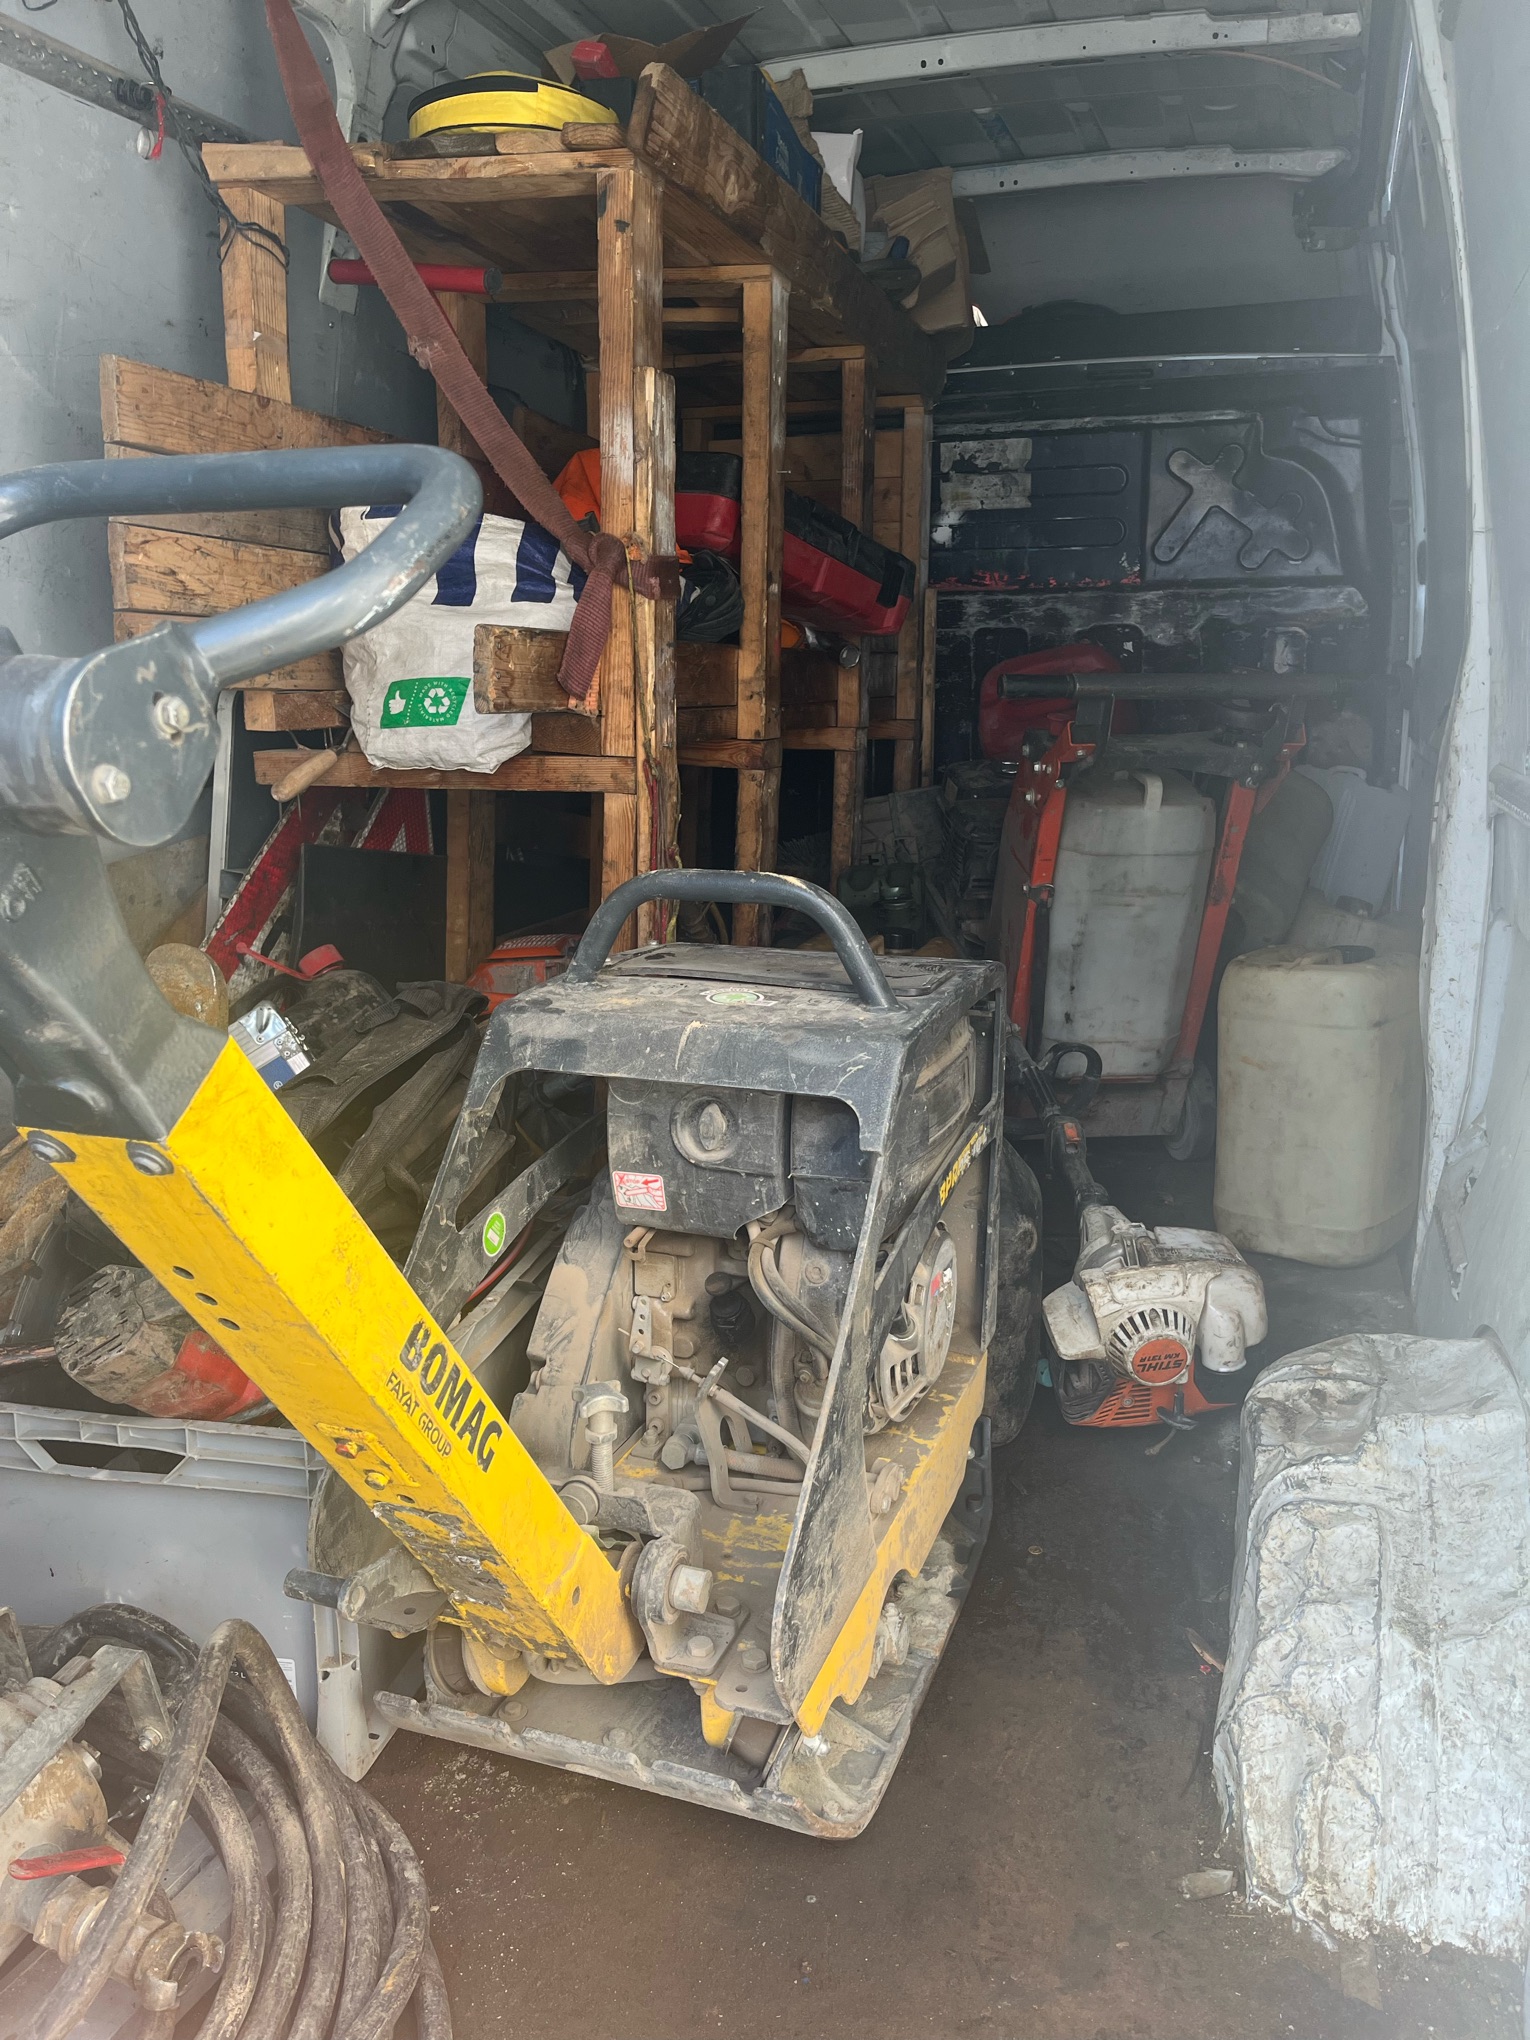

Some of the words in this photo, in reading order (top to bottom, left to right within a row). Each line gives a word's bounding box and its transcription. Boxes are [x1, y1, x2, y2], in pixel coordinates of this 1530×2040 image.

[419, 683, 432, 698] MADE
[433, 681, 449, 689] WITH
[447, 688, 457, 718] RECYCLED
[418, 703, 445, 722] MATERIALS
[1164, 1352, 1181, 1360] KM
[1137, 1359, 1185, 1373] STIHL
[399, 1319, 503, 1473] BOMAG
[385, 1370, 420, 1418] FAYAT
[418, 1412, 452, 1458] GROUP
